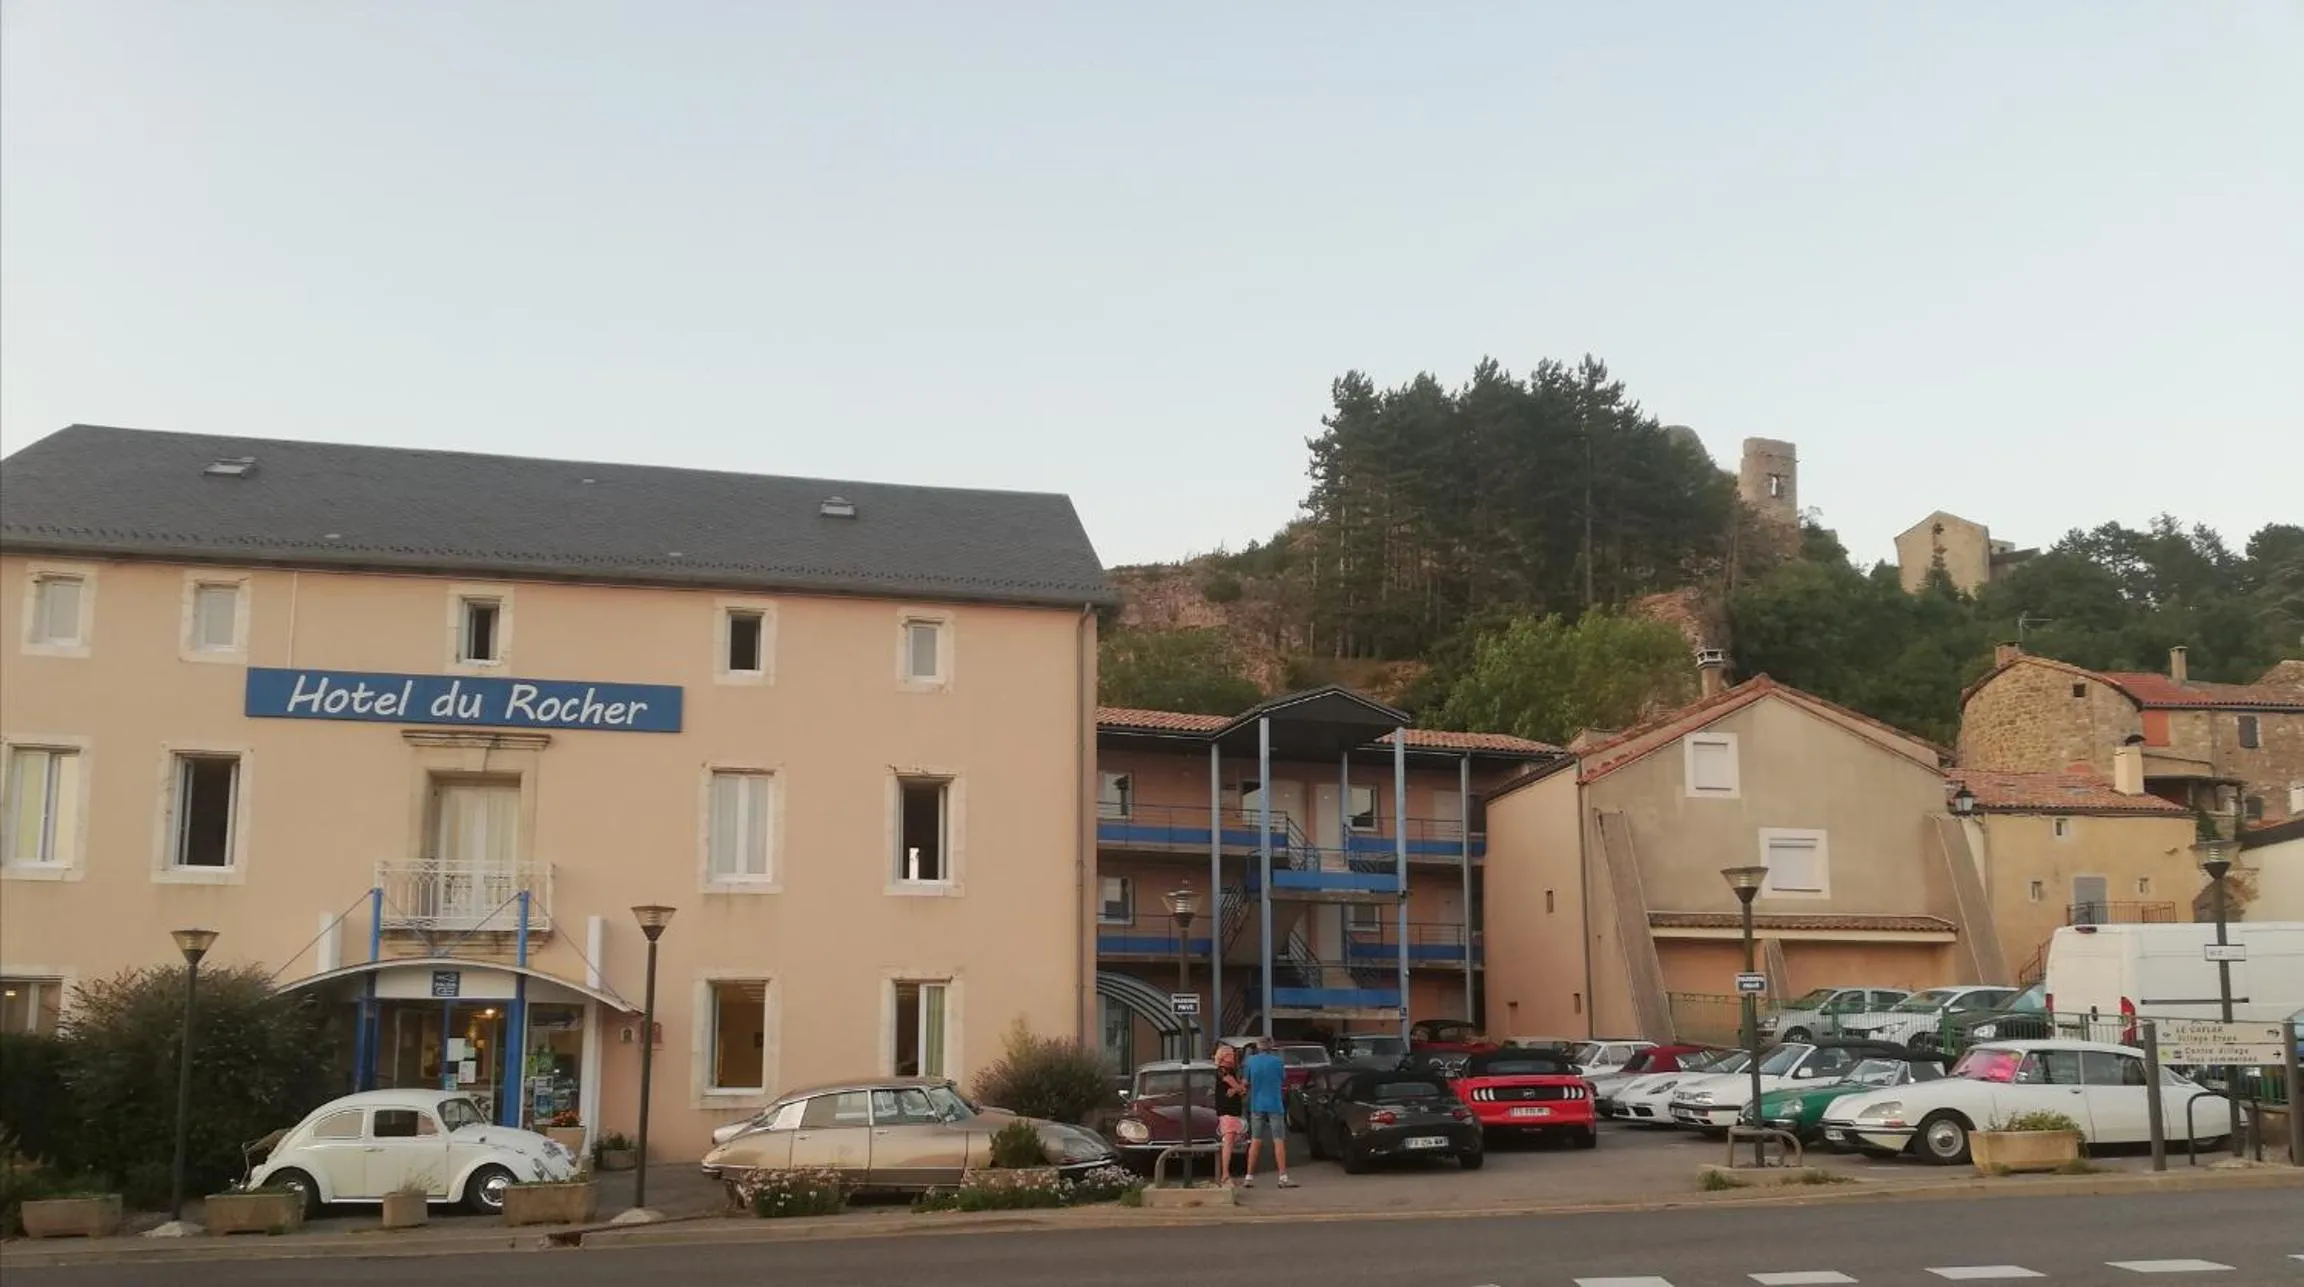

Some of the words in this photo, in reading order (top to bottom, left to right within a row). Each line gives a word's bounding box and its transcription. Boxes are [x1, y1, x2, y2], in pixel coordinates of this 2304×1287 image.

[287, 674, 413, 717] Hotel
[430, 681, 483, 719] du
[504, 683, 649, 726] Rocher
